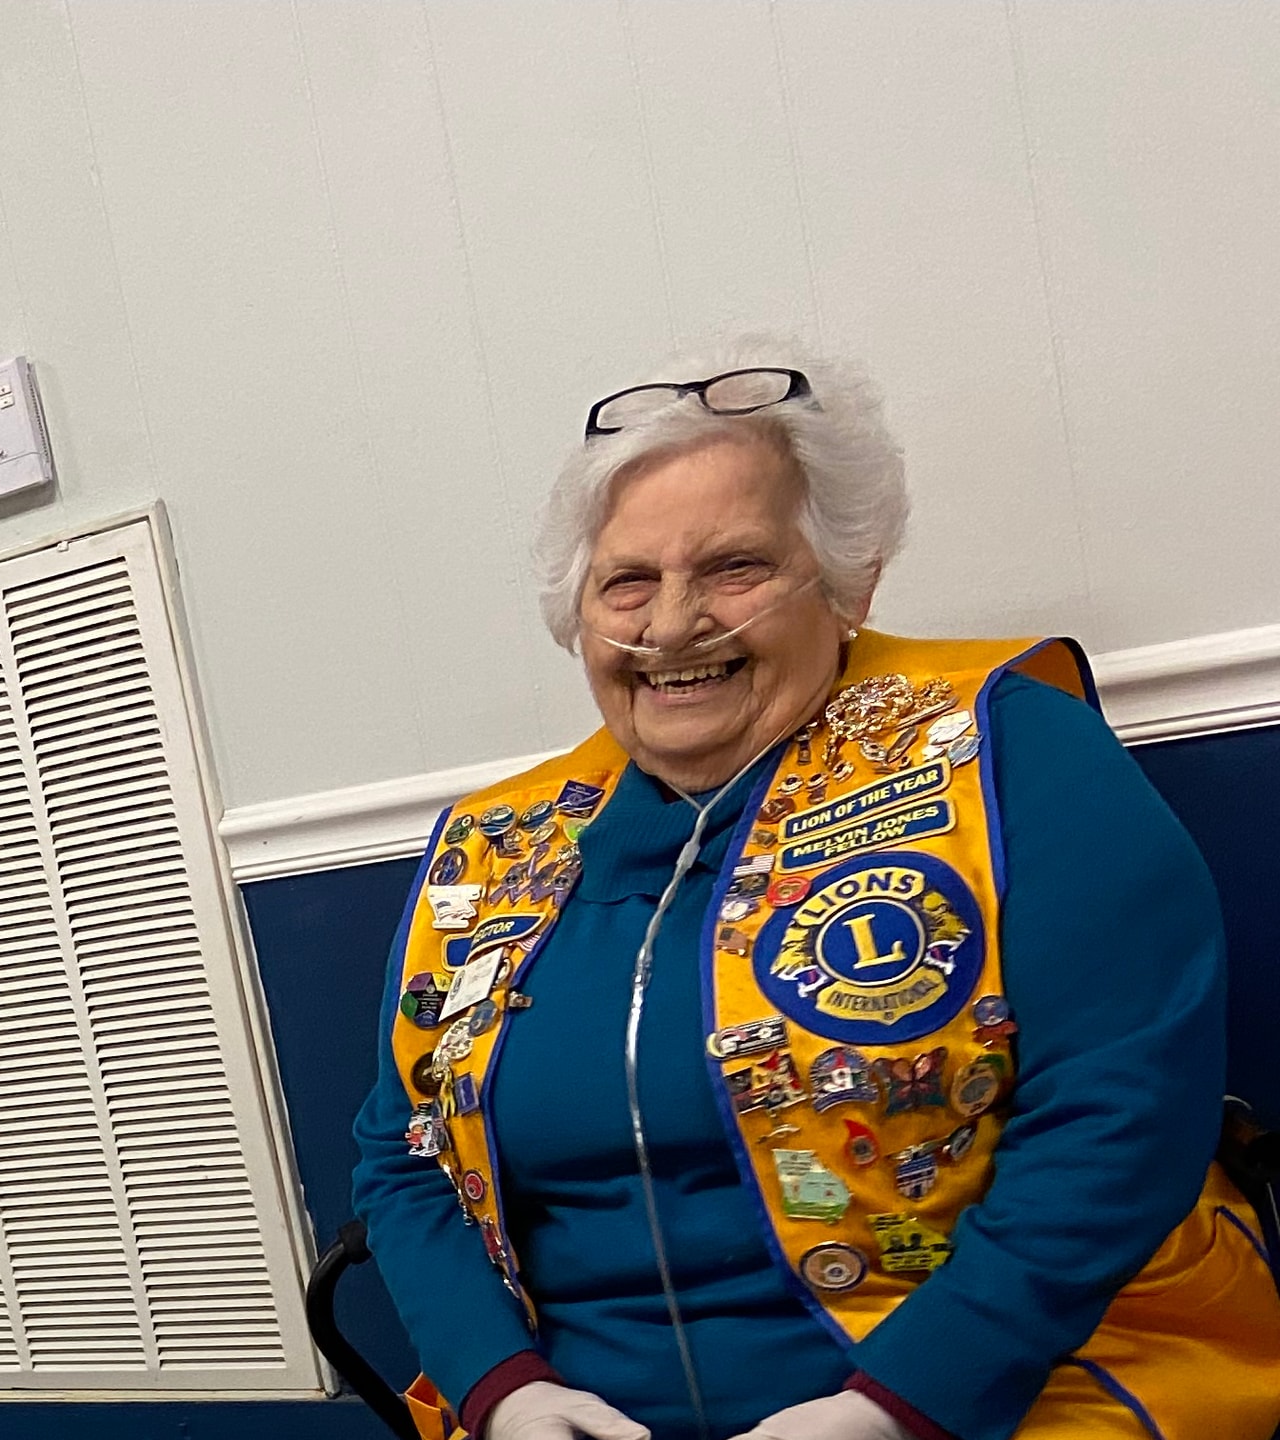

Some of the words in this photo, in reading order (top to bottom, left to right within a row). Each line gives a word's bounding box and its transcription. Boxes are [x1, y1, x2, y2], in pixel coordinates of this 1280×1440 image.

[792, 809, 831, 834] LION
[833, 799, 857, 818] OF
[858, 785, 891, 809] THE
[893, 768, 939, 794] YEAR
[792, 826, 869, 858] MELVIN
[873, 805, 939, 835] JONES
[823, 823, 907, 858] FELLOW
[801, 872, 917, 919] LIONS
[842, 913, 907, 970] L
